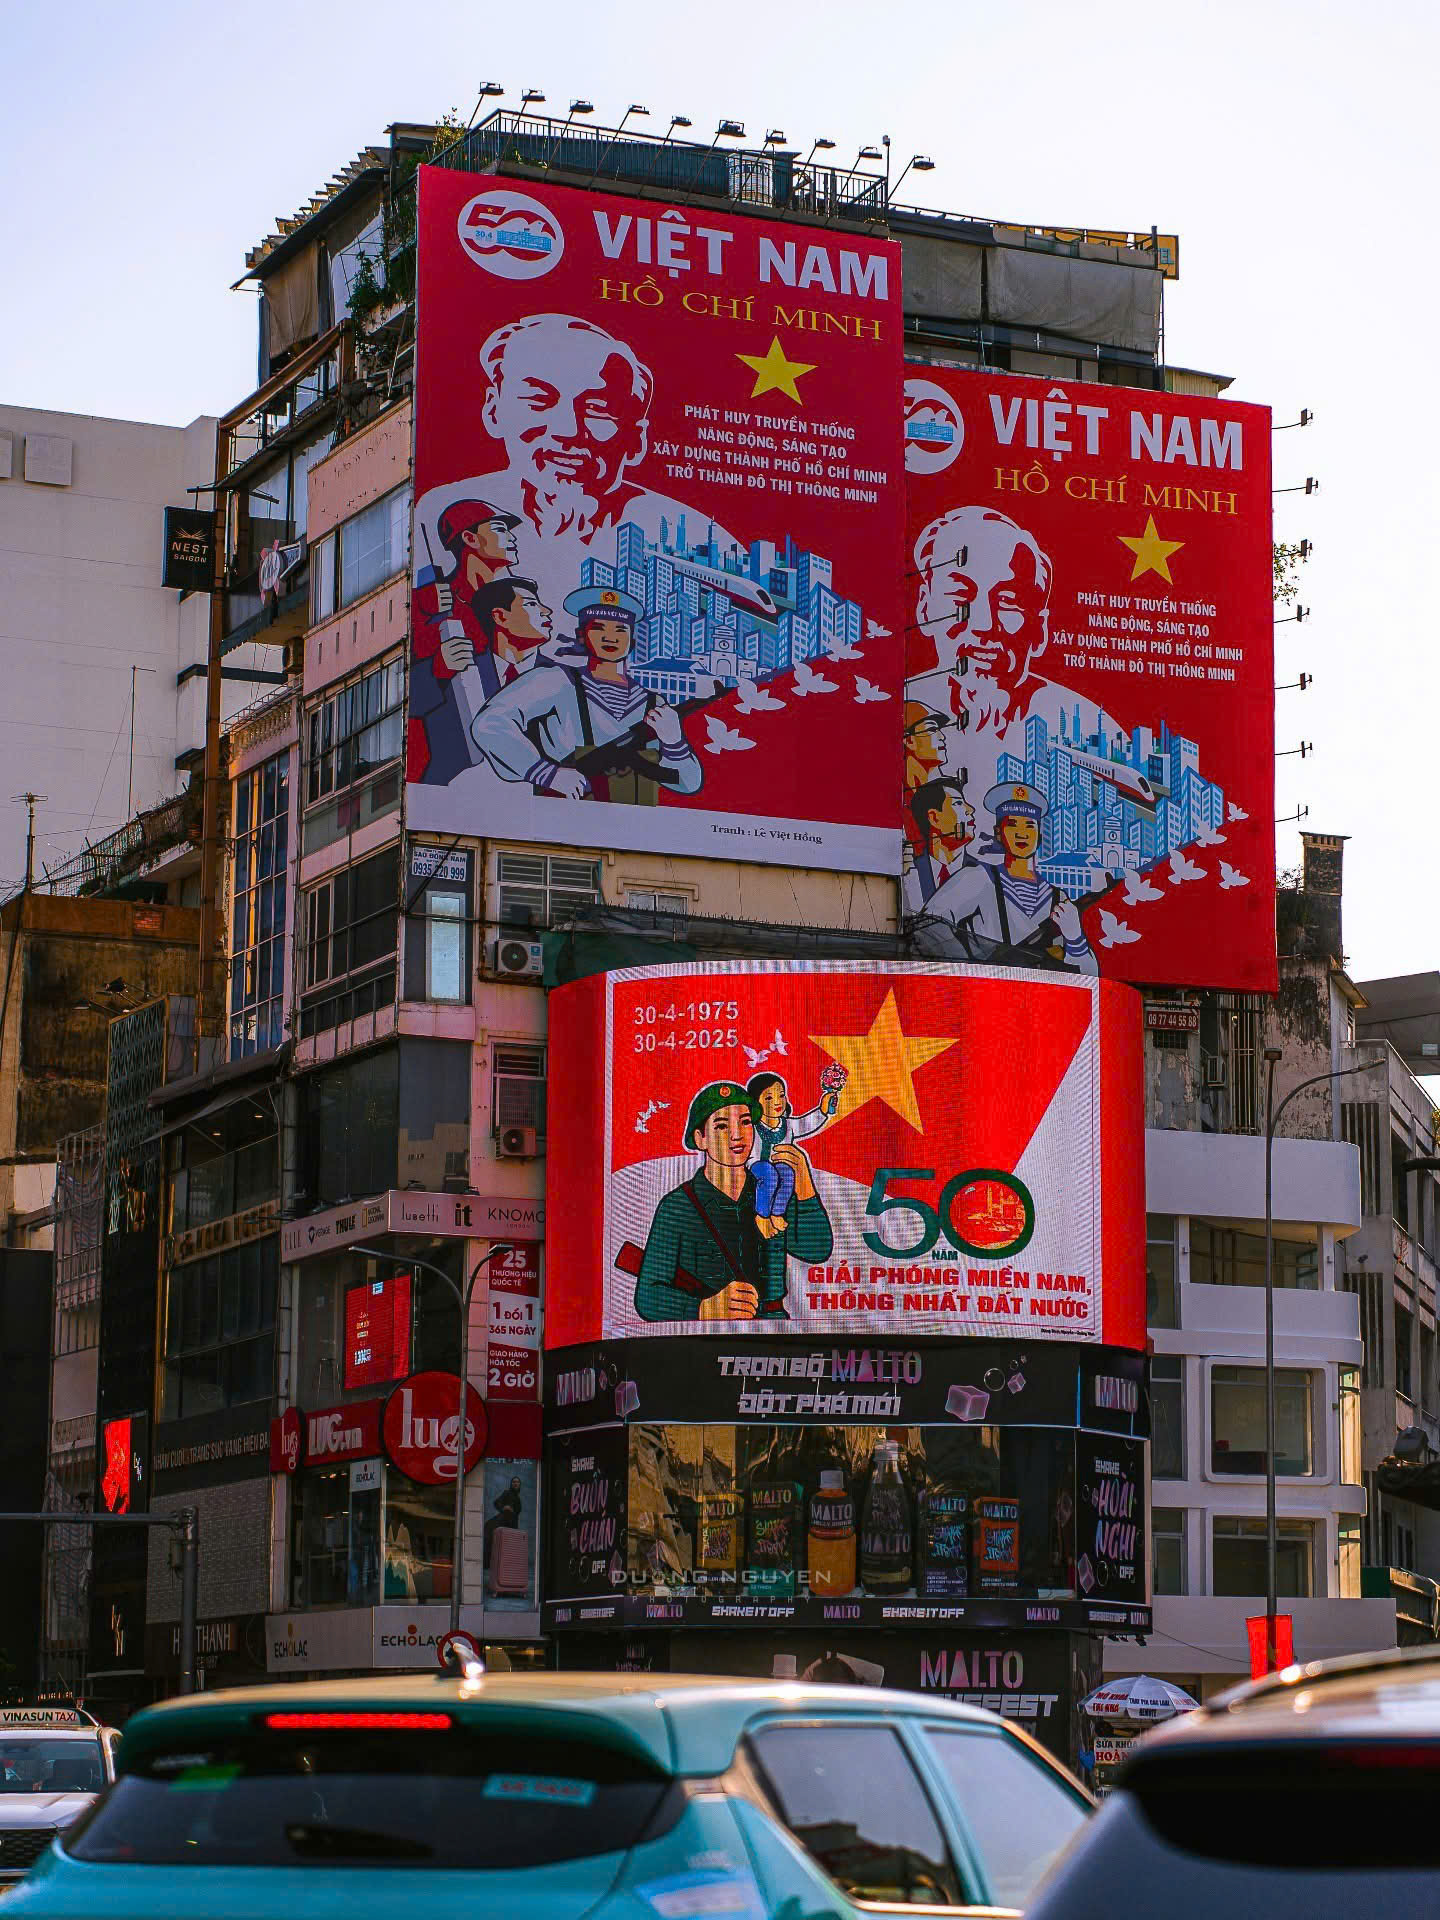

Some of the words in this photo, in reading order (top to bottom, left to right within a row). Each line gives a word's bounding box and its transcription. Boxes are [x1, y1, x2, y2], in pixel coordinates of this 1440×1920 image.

[592, 209, 734, 279] VIỆT
[759, 236, 889, 301] NAM
[599, 274, 664, 306] HỒ
[682, 291, 755, 321] CHÍ
[771, 305, 884, 341] MINH
[684, 404, 720, 421] PHÁT
[724, 409, 751, 425] HUY
[754, 414, 807, 434] TRUYỀN
[811, 421, 855, 440] THỐNG
[988, 387, 1109, 462] VIỆT
[1130, 410, 1243, 471] NAM
[698, 427, 734, 444] NĂNG
[738, 431, 778, 451] ĐỘNG,
[782, 437, 817, 455] SÁNG
[820, 443, 847, 460] TẠO
[653, 440, 680, 456] XÂY
[684, 445, 721, 463] DỰNG
[725, 449, 769, 469] THÀNH
[774, 456, 802, 473] PHỐ
[805, 459, 824, 476] HỒ
[827, 464, 850, 480] CHÍ
[853, 468, 887, 485] MINH
[666, 462, 694, 479] TRỞ
[698, 466, 743, 486] THÀNH
[746, 473, 766, 489] ĐÔ
[770, 477, 792, 495] THỊ
[796, 480, 840, 499] THÔNG
[844, 487, 878, 503] MINH
[993, 459, 1050, 494] HỒ
[1064, 475, 1128, 504] CHÍ
[1143, 483, 1238, 515] MINH
[171, 541, 209, 555] NEST
[173, 553, 207, 564] SAIGON
[1077, 591, 1107, 606] PHÁT
[1109, 595, 1131, 609] HUY
[1134, 595, 1177, 614] TRUYỀN
[1180, 599, 1217, 617] THỐNG
[1088, 613, 1117, 629] NĂNG
[1120, 615, 1154, 634] ĐỘNG,
[1156, 620, 1185, 635] SÁNG
[1188, 623, 1210, 637] TẠO
[1053, 629, 1074, 645] XÂY
[1077, 634, 1108, 649] DỰNG
[1110, 636, 1147, 653] THÀNH
[1150, 639, 1173, 655] PHỐ
[1175, 639, 1190, 657] HỒ
[1194, 644, 1212, 658] CHÍ
[1215, 647, 1243, 661] MINH
[1064, 651, 1086, 668] TRỞ
[1089, 656, 1126, 672] THÀNH
[1129, 658, 1144, 674] ĐÔ
[1147, 662, 1165, 678] THỊ
[1168, 662, 1205, 679] THÔNG
[1208, 667, 1235, 681] MINH
[711, 824, 745, 835] Tranh
[754, 828, 766, 837] Lê
[769, 830, 791, 841] Việt
[793, 832, 823, 844] Hồng
[450, 866, 465, 880] 999
[633, 1001, 739, 1025] 30-4-1975
[633, 1029, 739, 1053] 30-4-2025
[455, 1203, 473, 1227] it
[861, 1167, 1036, 1260] 50
[502, 1250, 527, 1269] 25
[932, 1249, 958, 1261] NĂM
[808, 1259, 861, 1284] GIẢI
[869, 1264, 960, 1286] PHÓNG
[967, 1265, 1030, 1289] MIỀN
[1036, 1273, 1092, 1296] NAM,
[492, 1301, 501, 1320] 1
[525, 1303, 534, 1321] 1
[806, 1286, 895, 1311] THỐNG
[903, 1288, 971, 1313] NHẤT
[976, 1292, 1023, 1315] ĐẤT
[1030, 1297, 1088, 1319] NƯỚC
[489, 1324, 506, 1334] 365
[508, 1324, 536, 1336] NGÀY
[489, 1349, 508, 1358] GIAO
[508, 1349, 529, 1359] HÀNG
[717, 1356, 786, 1382] TRỌN
[831, 1349, 922, 1385] MALTO
[488, 1367, 501, 1387] 2
[503, 1369, 535, 1389] GIỜ
[281, 1417, 298, 1470] lug
[399, 1388, 476, 1477] lug
[920, 1650, 1024, 1689] MALTO
[3, 1711, 53, 1721] VINASUN
[55, 1711, 76, 1721] TAXI
